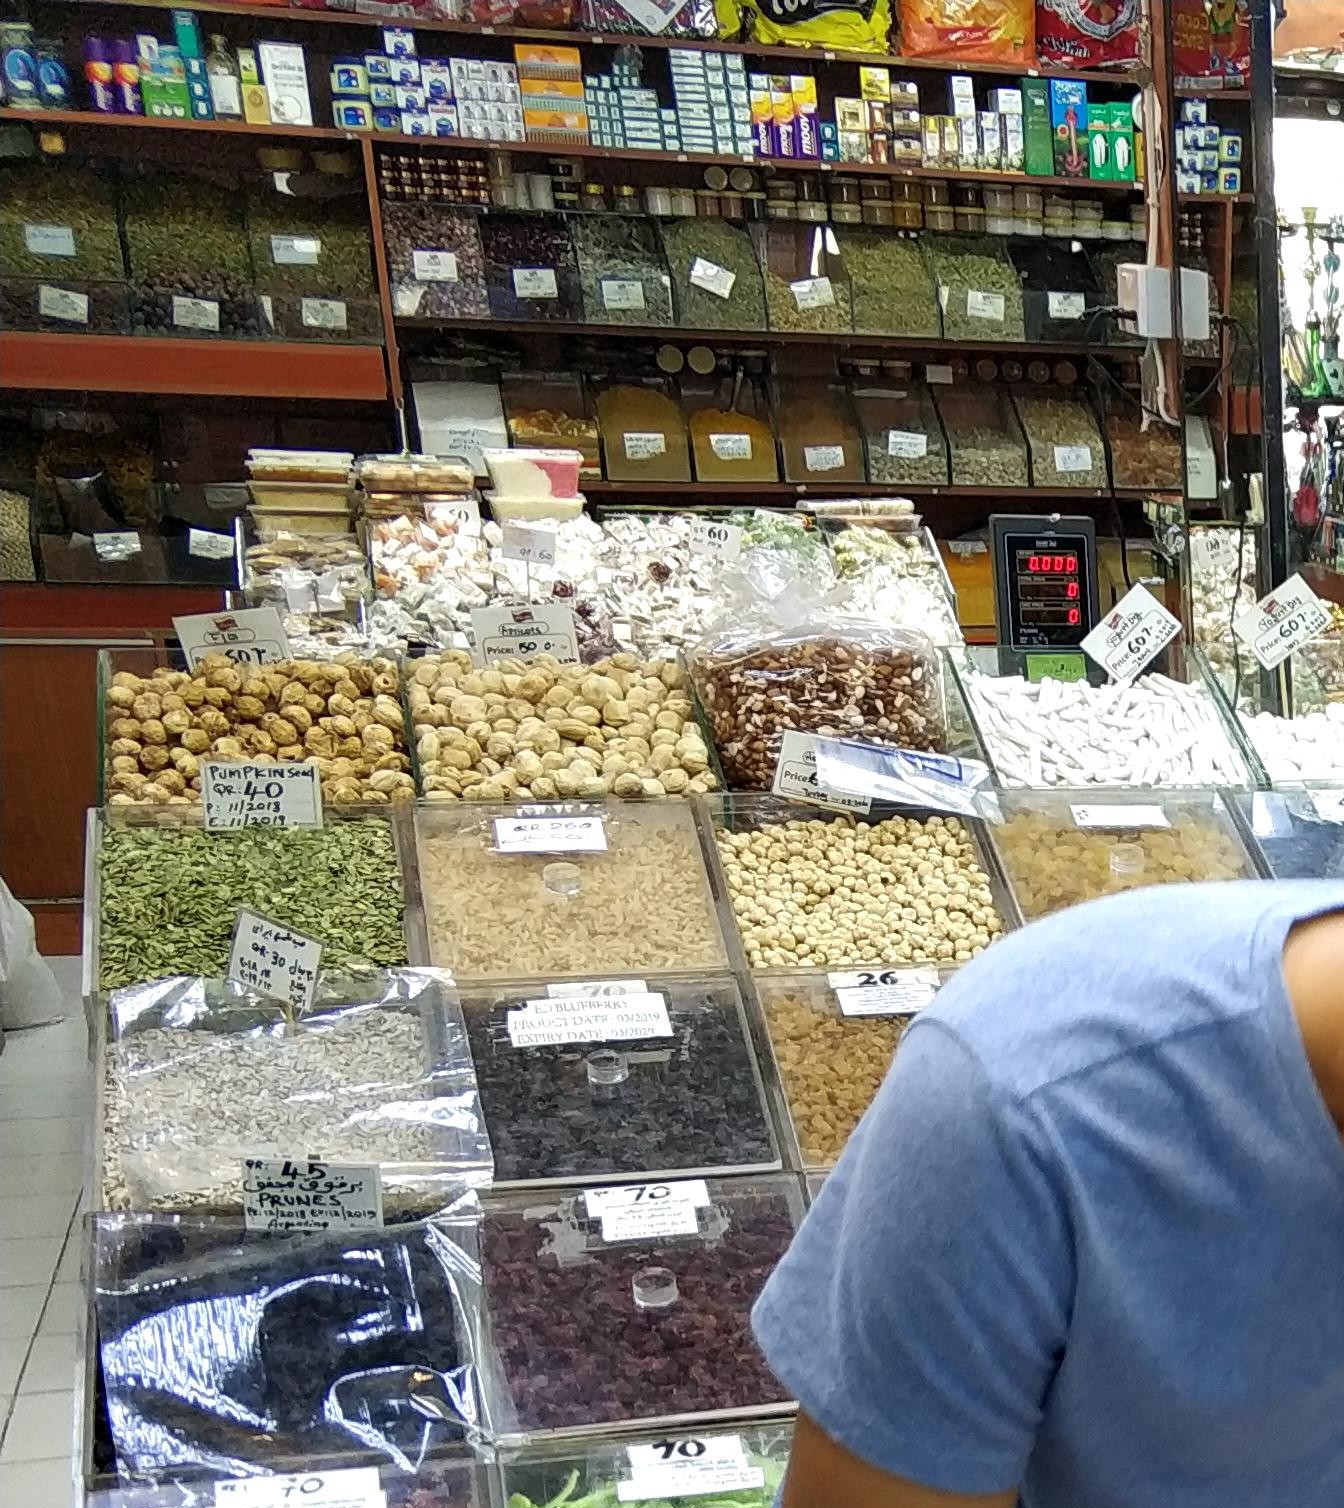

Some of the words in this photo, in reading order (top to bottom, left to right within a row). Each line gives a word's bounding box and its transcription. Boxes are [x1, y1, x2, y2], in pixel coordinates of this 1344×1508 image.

[210, 765, 285, 780] PUMPKIN
[244, 781, 284, 801] 40
[856, 971, 899, 987] 26
[281, 1161, 329, 1180] 45
[258, 1192, 342, 1208] PRUNES
[624, 1185, 672, 1201] 70
[651, 1439, 706, 1460] 70
[281, 1476, 324, 1496] 70
